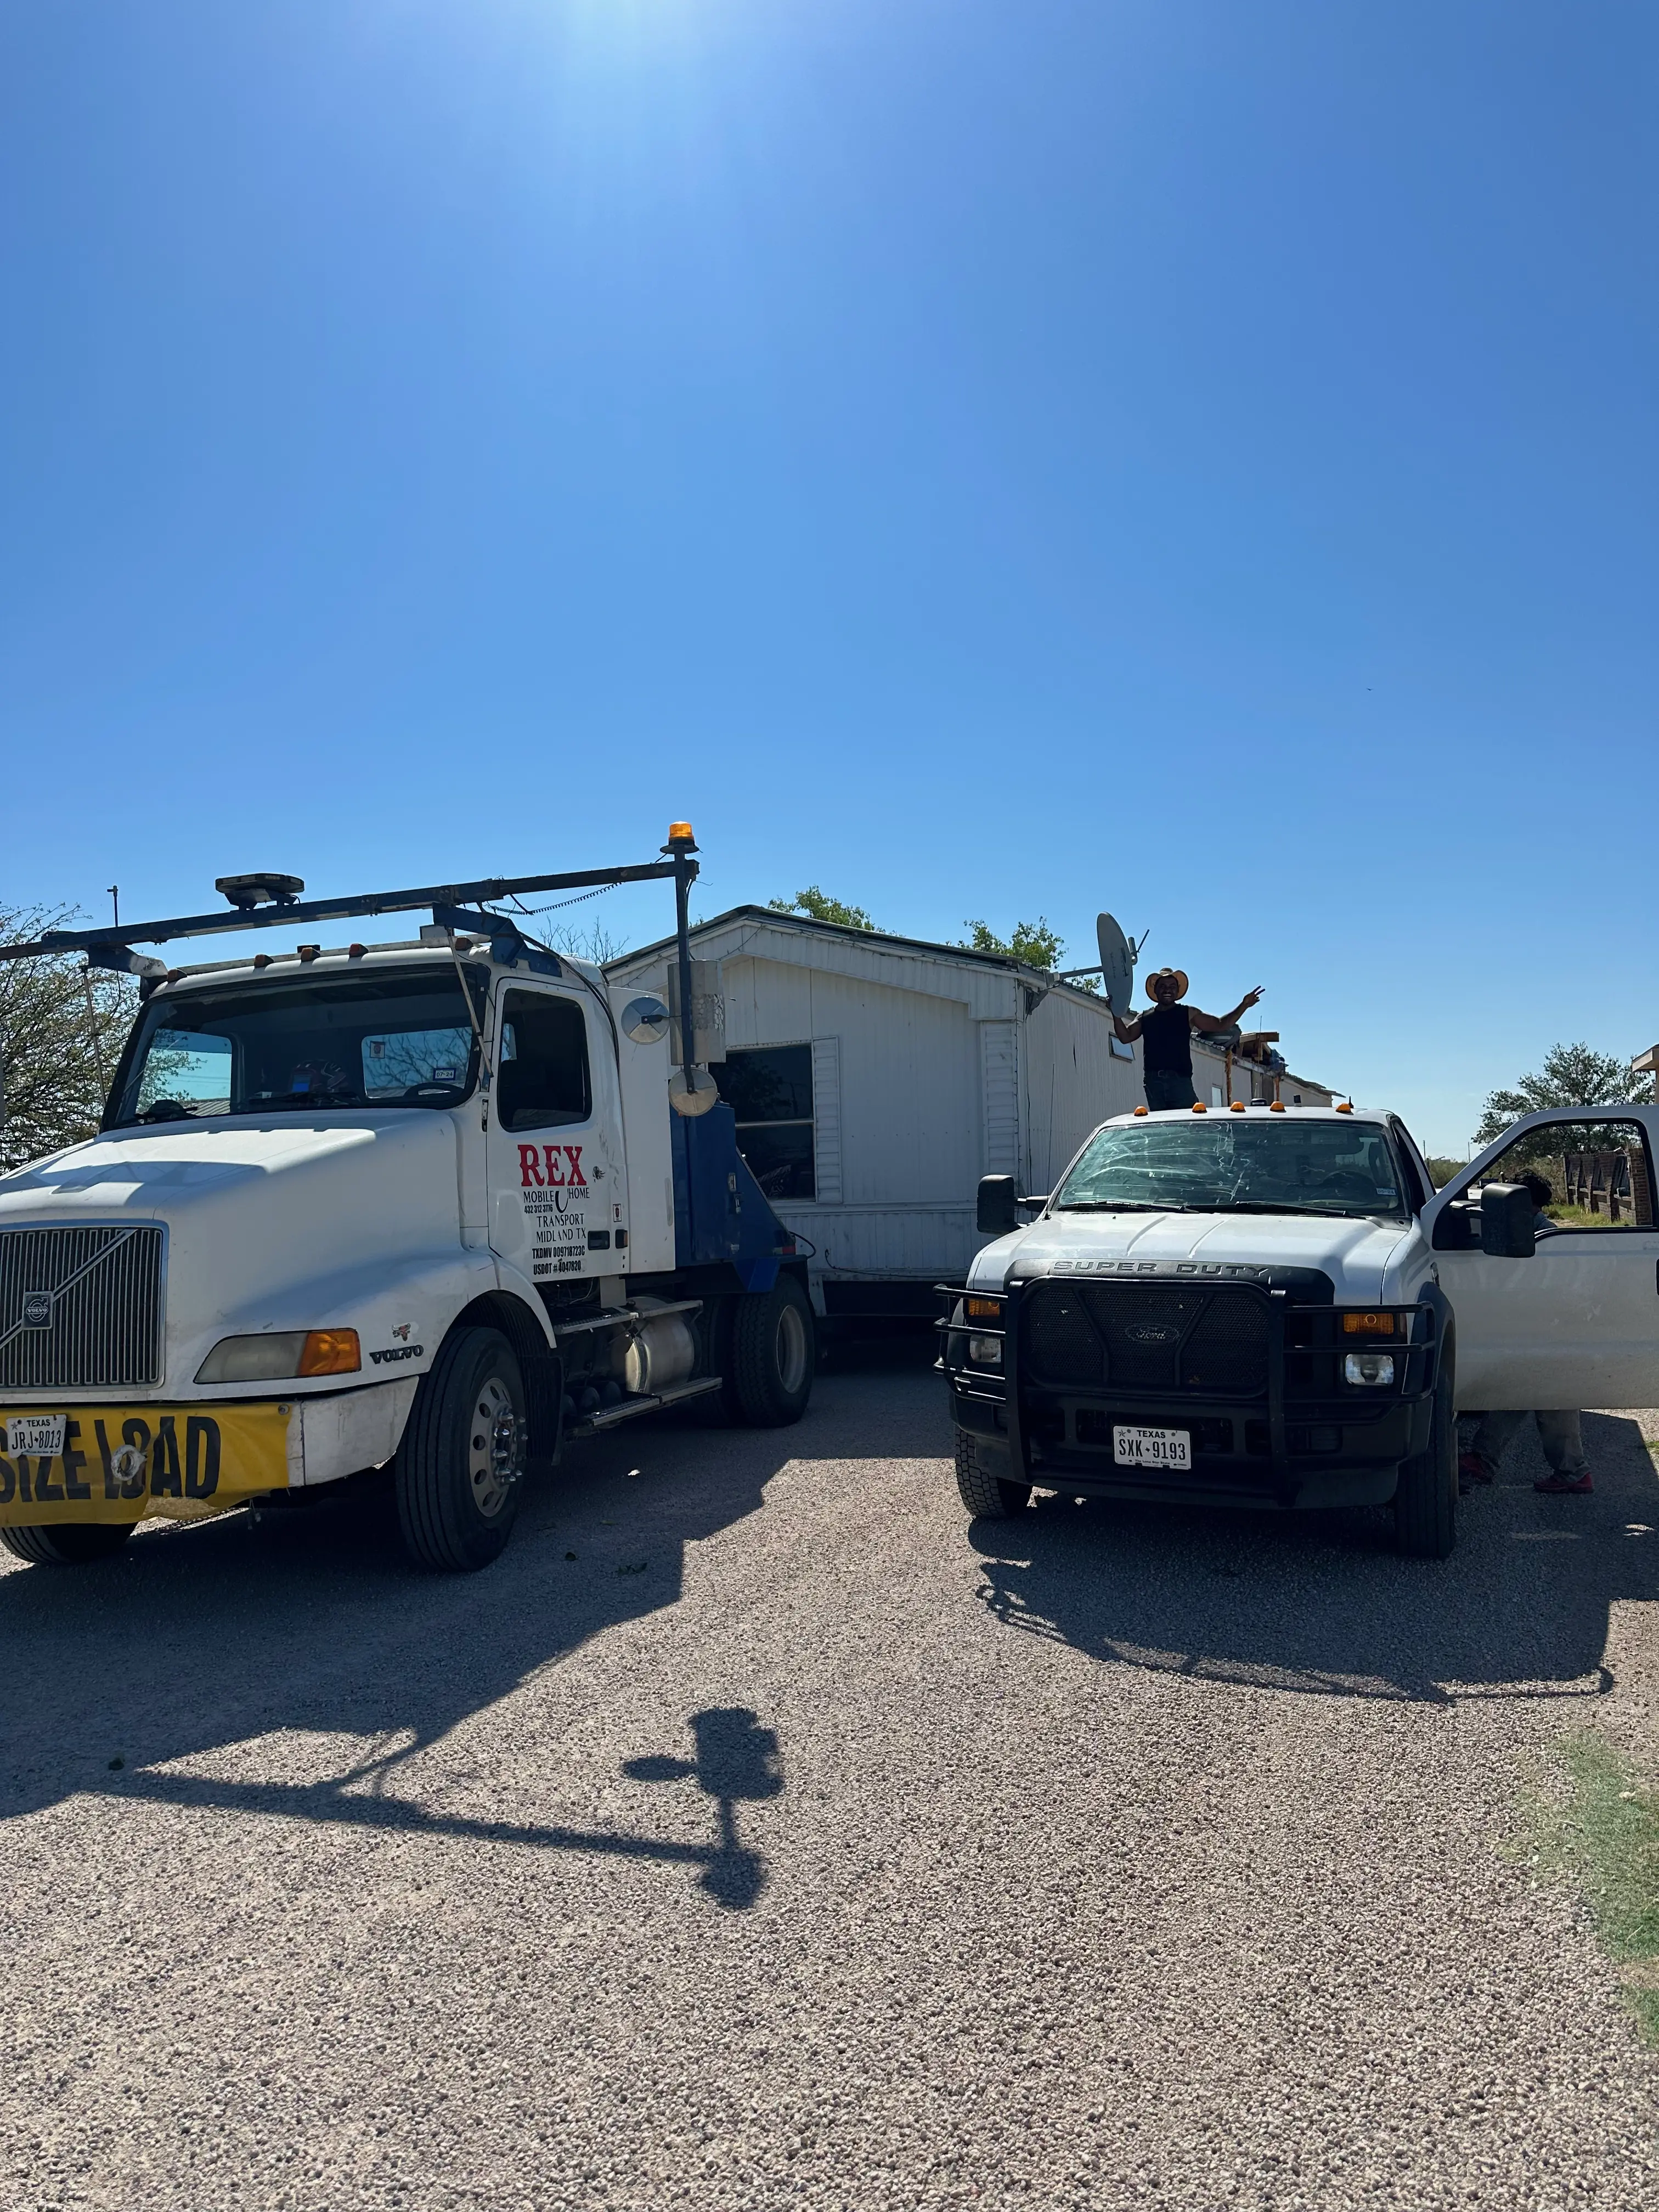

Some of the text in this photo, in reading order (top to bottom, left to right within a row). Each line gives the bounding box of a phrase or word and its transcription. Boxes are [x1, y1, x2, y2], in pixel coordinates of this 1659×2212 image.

[517, 1144, 586, 1187] REX
[523, 1187, 590, 1203] MOBILE HOME
[524, 1205, 533, 1214] 432
[534, 1205, 542, 1214] 312
[537, 1213, 584, 1227] TRANSPORT
[537, 1227, 586, 1244] MIDLAND TX
[532, 1247, 552, 1259] TXDMV
[533, 1263, 552, 1275] USDOT
[1054, 1261, 1269, 1277] SUPER DUTY
[369, 1345, 424, 1365] VOLVO
[26, 1419, 50, 1427] TEXAS
[1137, 1430, 1166, 1438] TEXAS
